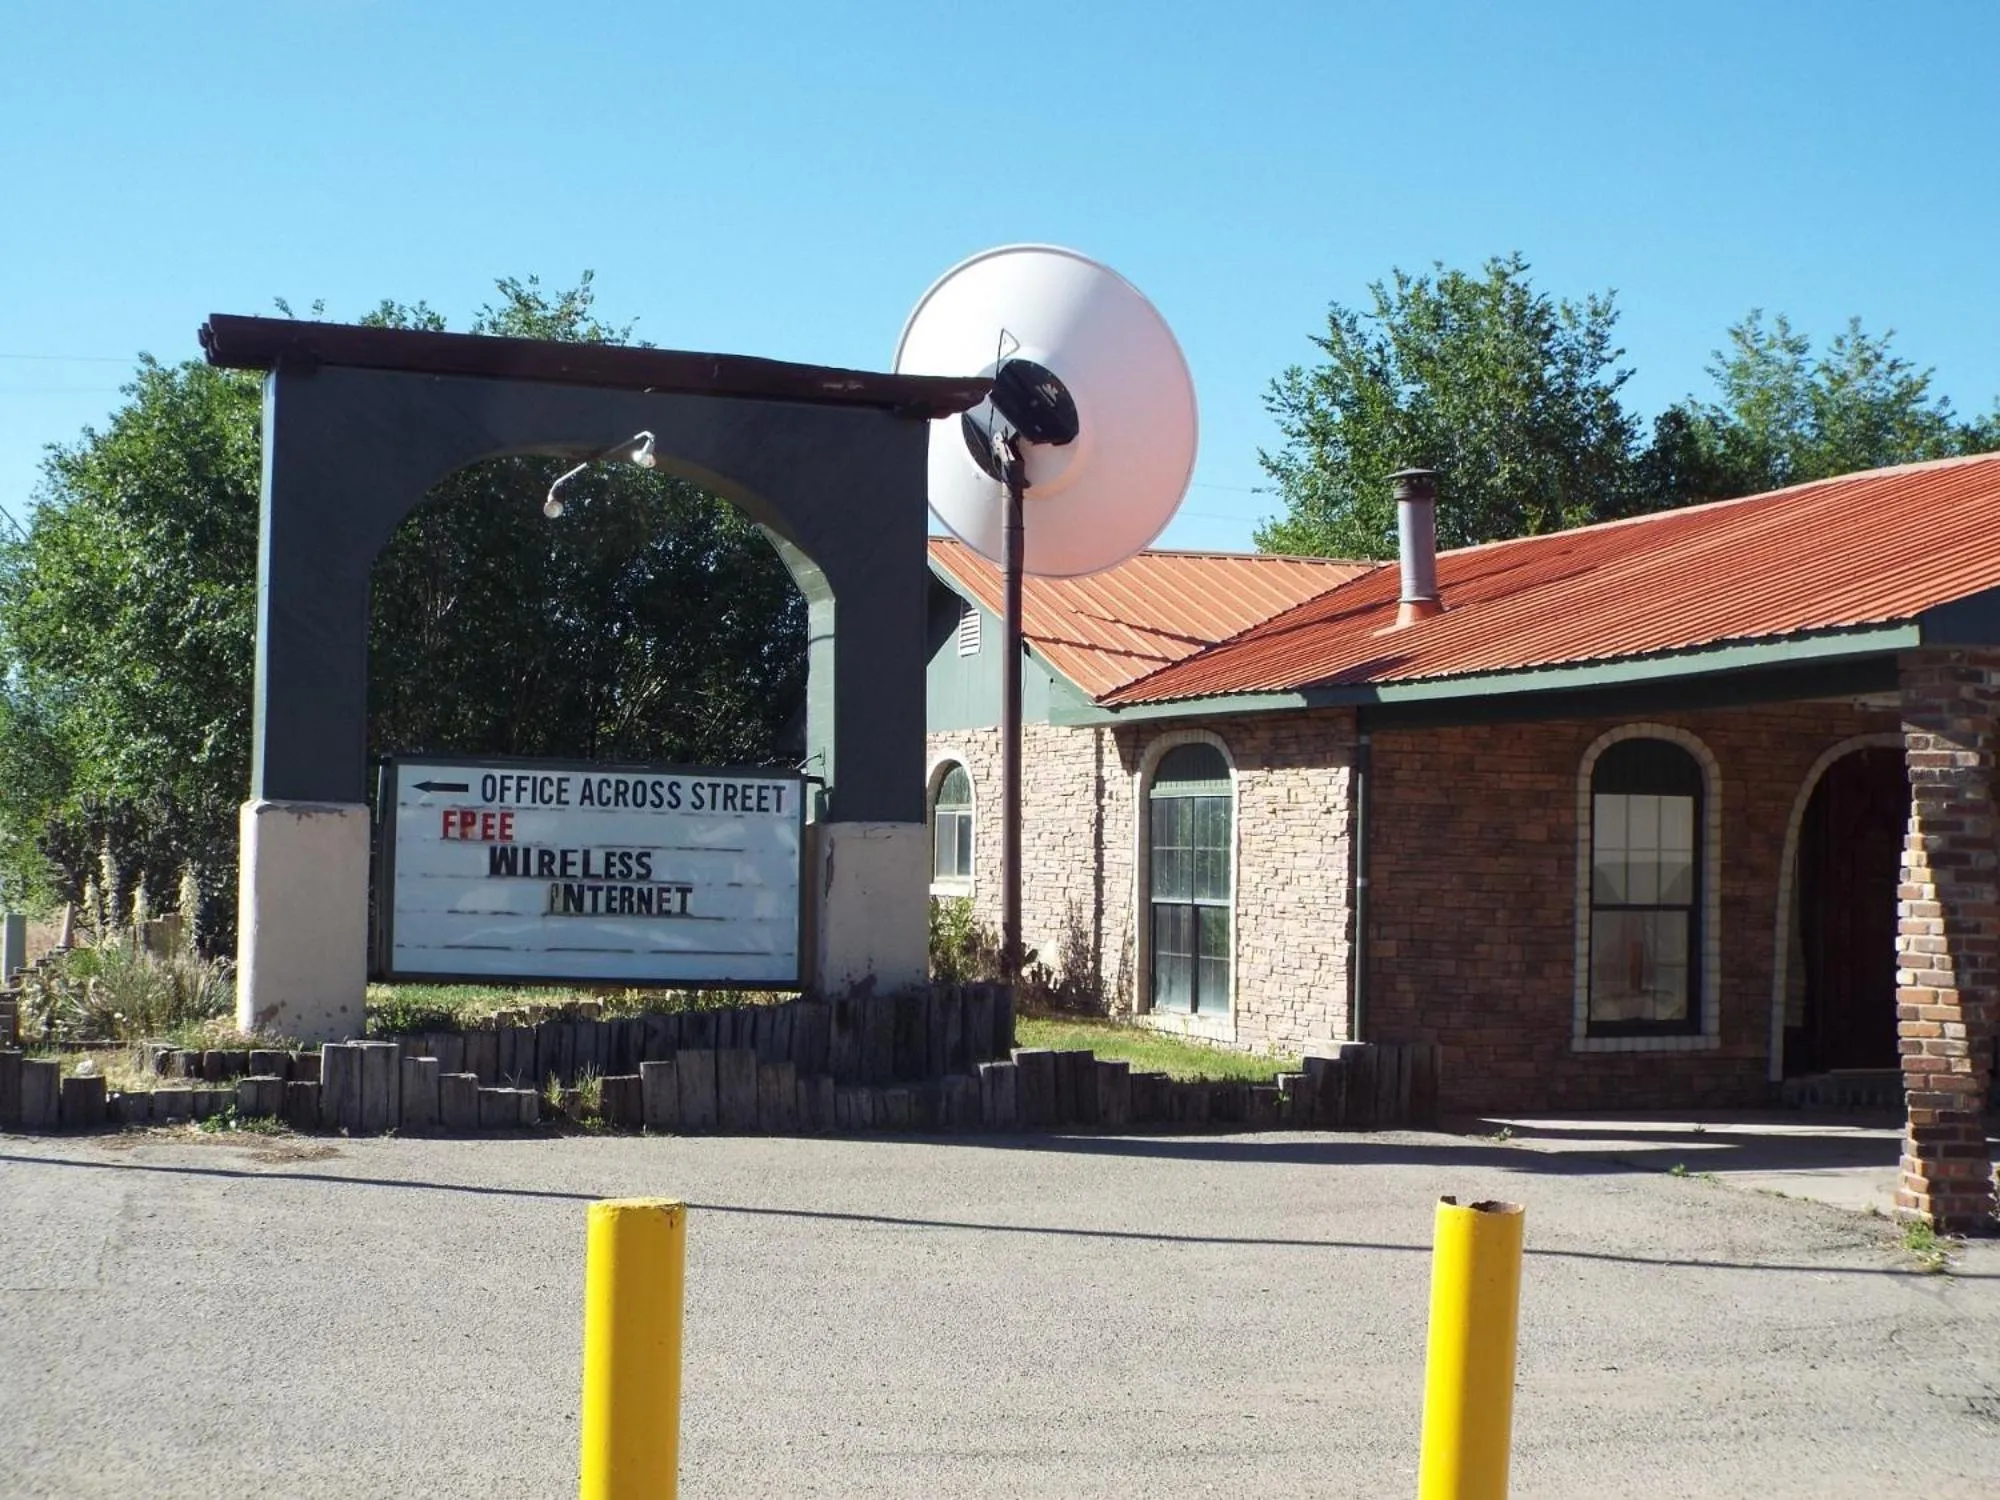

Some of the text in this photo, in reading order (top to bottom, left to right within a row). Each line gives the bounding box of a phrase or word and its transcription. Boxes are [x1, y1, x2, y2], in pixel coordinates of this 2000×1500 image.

[481, 774, 787, 813] OFFICE ACROSS STREET
[488, 845, 652, 880] WIRELESS
